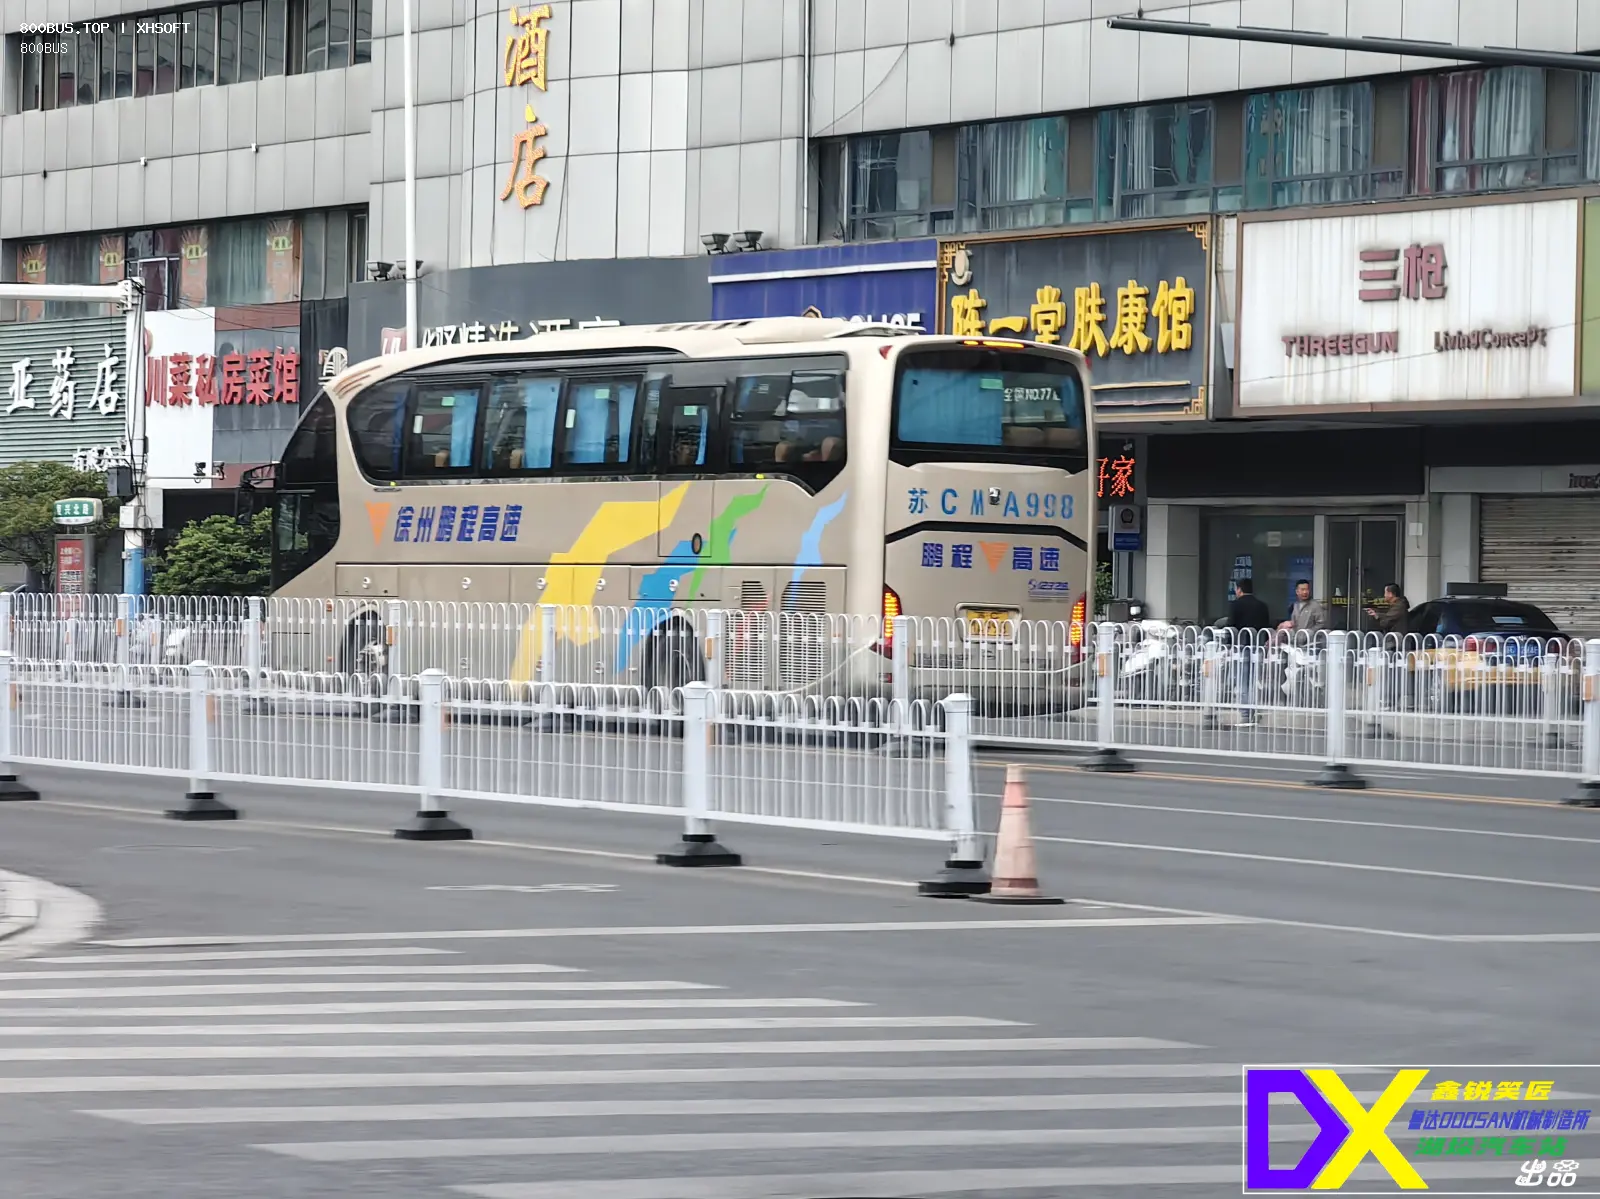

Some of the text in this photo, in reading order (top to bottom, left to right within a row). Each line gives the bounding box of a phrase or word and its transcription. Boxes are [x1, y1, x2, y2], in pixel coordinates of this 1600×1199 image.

[501, 4, 552, 210] 酒店
[1358, 243, 1448, 301] 三枪
[951, 276, 1195, 357] 陈一堂肤康馆
[1281, 330, 1399, 358] THREEGUN
[6, 343, 122, 420] 亚药店
[145, 346, 300, 408] 川菜私房菜馆
[393, 504, 523, 542] 徐州鹏程高速
[921, 542, 1060, 571] 鹏程 高速
